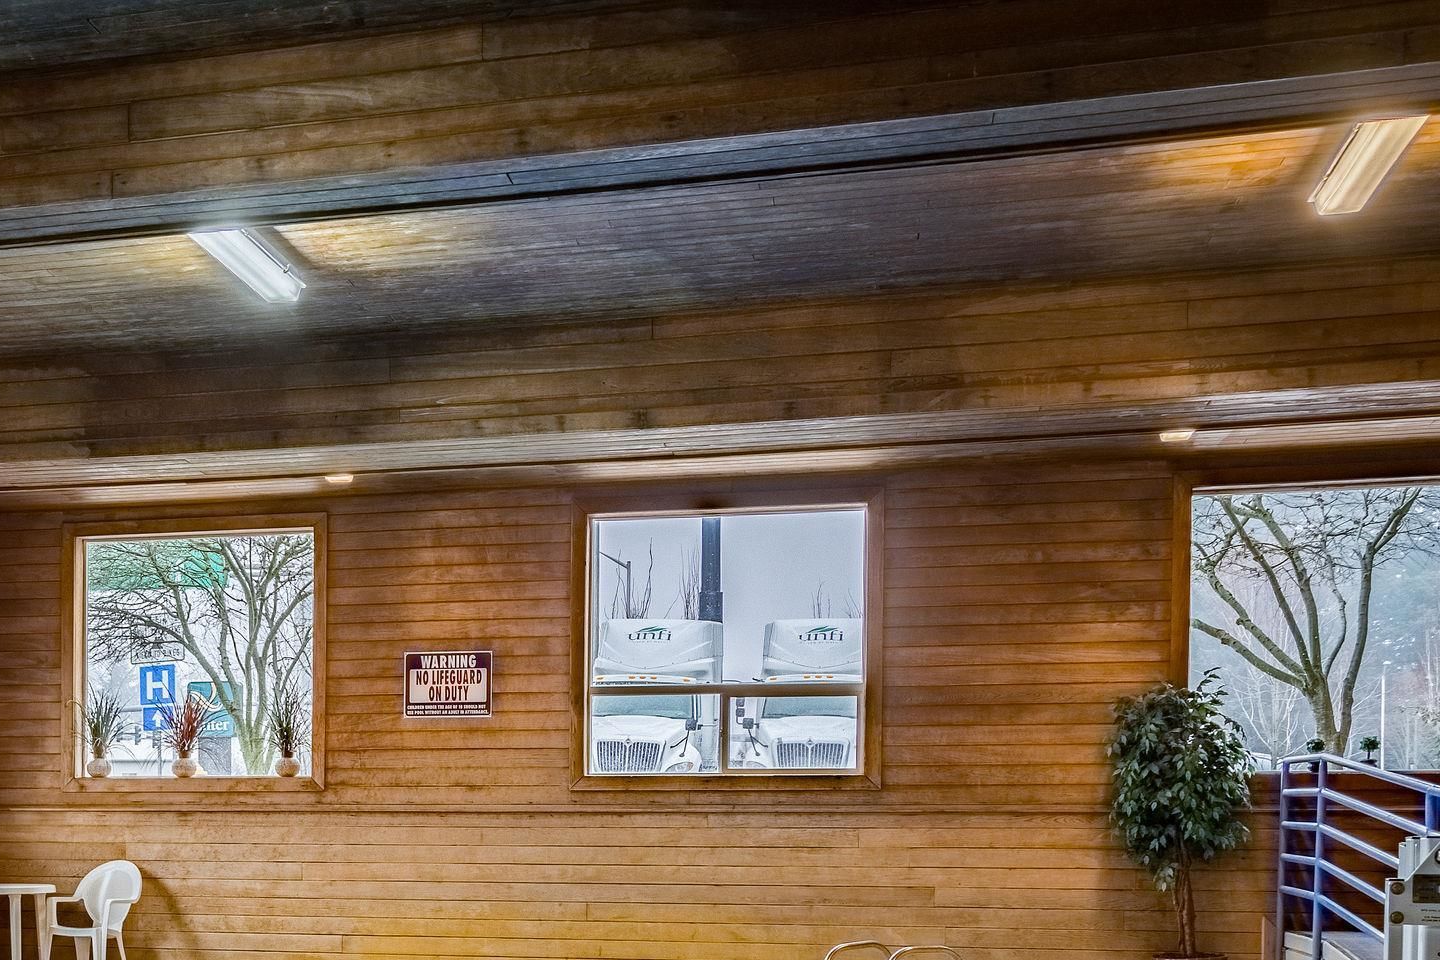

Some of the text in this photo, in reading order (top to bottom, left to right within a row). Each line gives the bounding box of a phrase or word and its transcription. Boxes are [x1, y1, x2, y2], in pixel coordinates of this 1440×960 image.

[420, 655, 477, 669] WARNING
[416, 669, 482, 685] NO LIFEGUARD
[146, 670, 170, 700] H
[429, 686, 469, 701] ON DUTY
